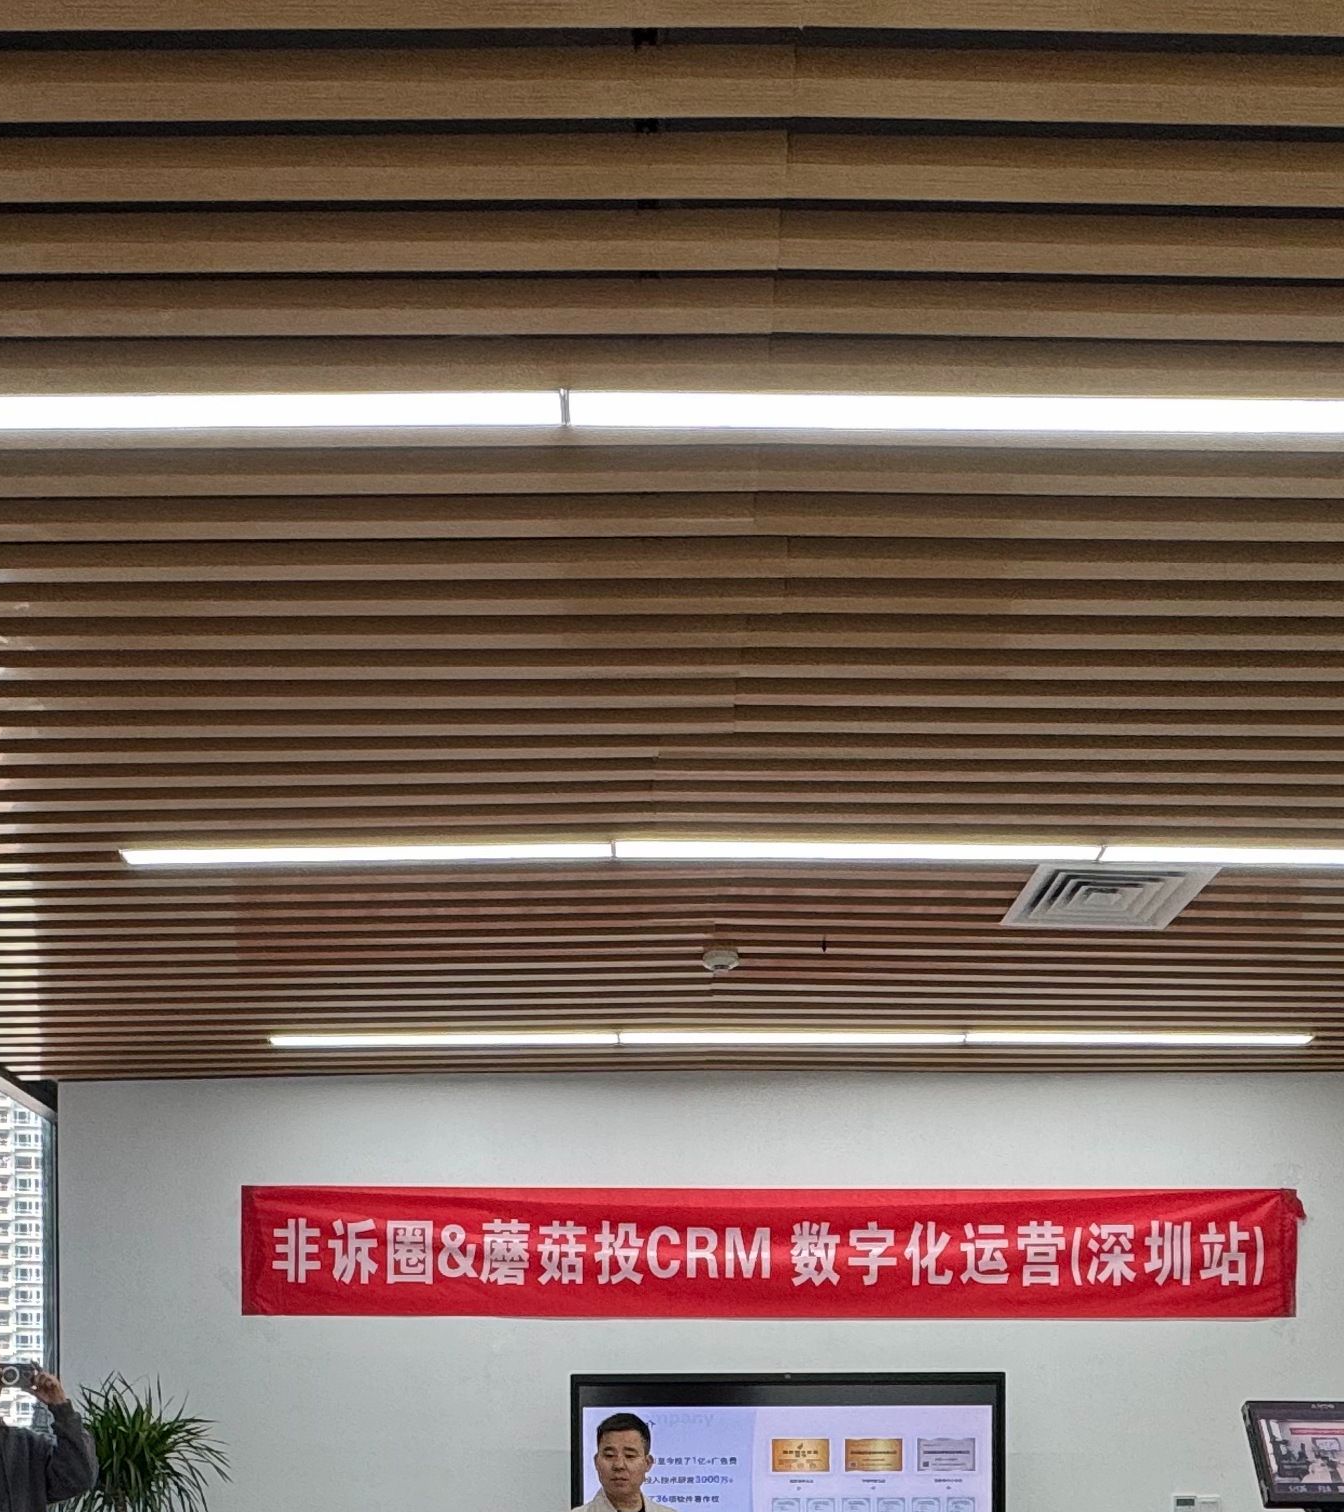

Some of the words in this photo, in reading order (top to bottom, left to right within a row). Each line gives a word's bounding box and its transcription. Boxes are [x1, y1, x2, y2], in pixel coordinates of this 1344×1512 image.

[271, 1218, 771, 1286] 非诉圈&蘑菇投CRM
[790, 1220, 1265, 1287] 数字化运营(深圳站)
